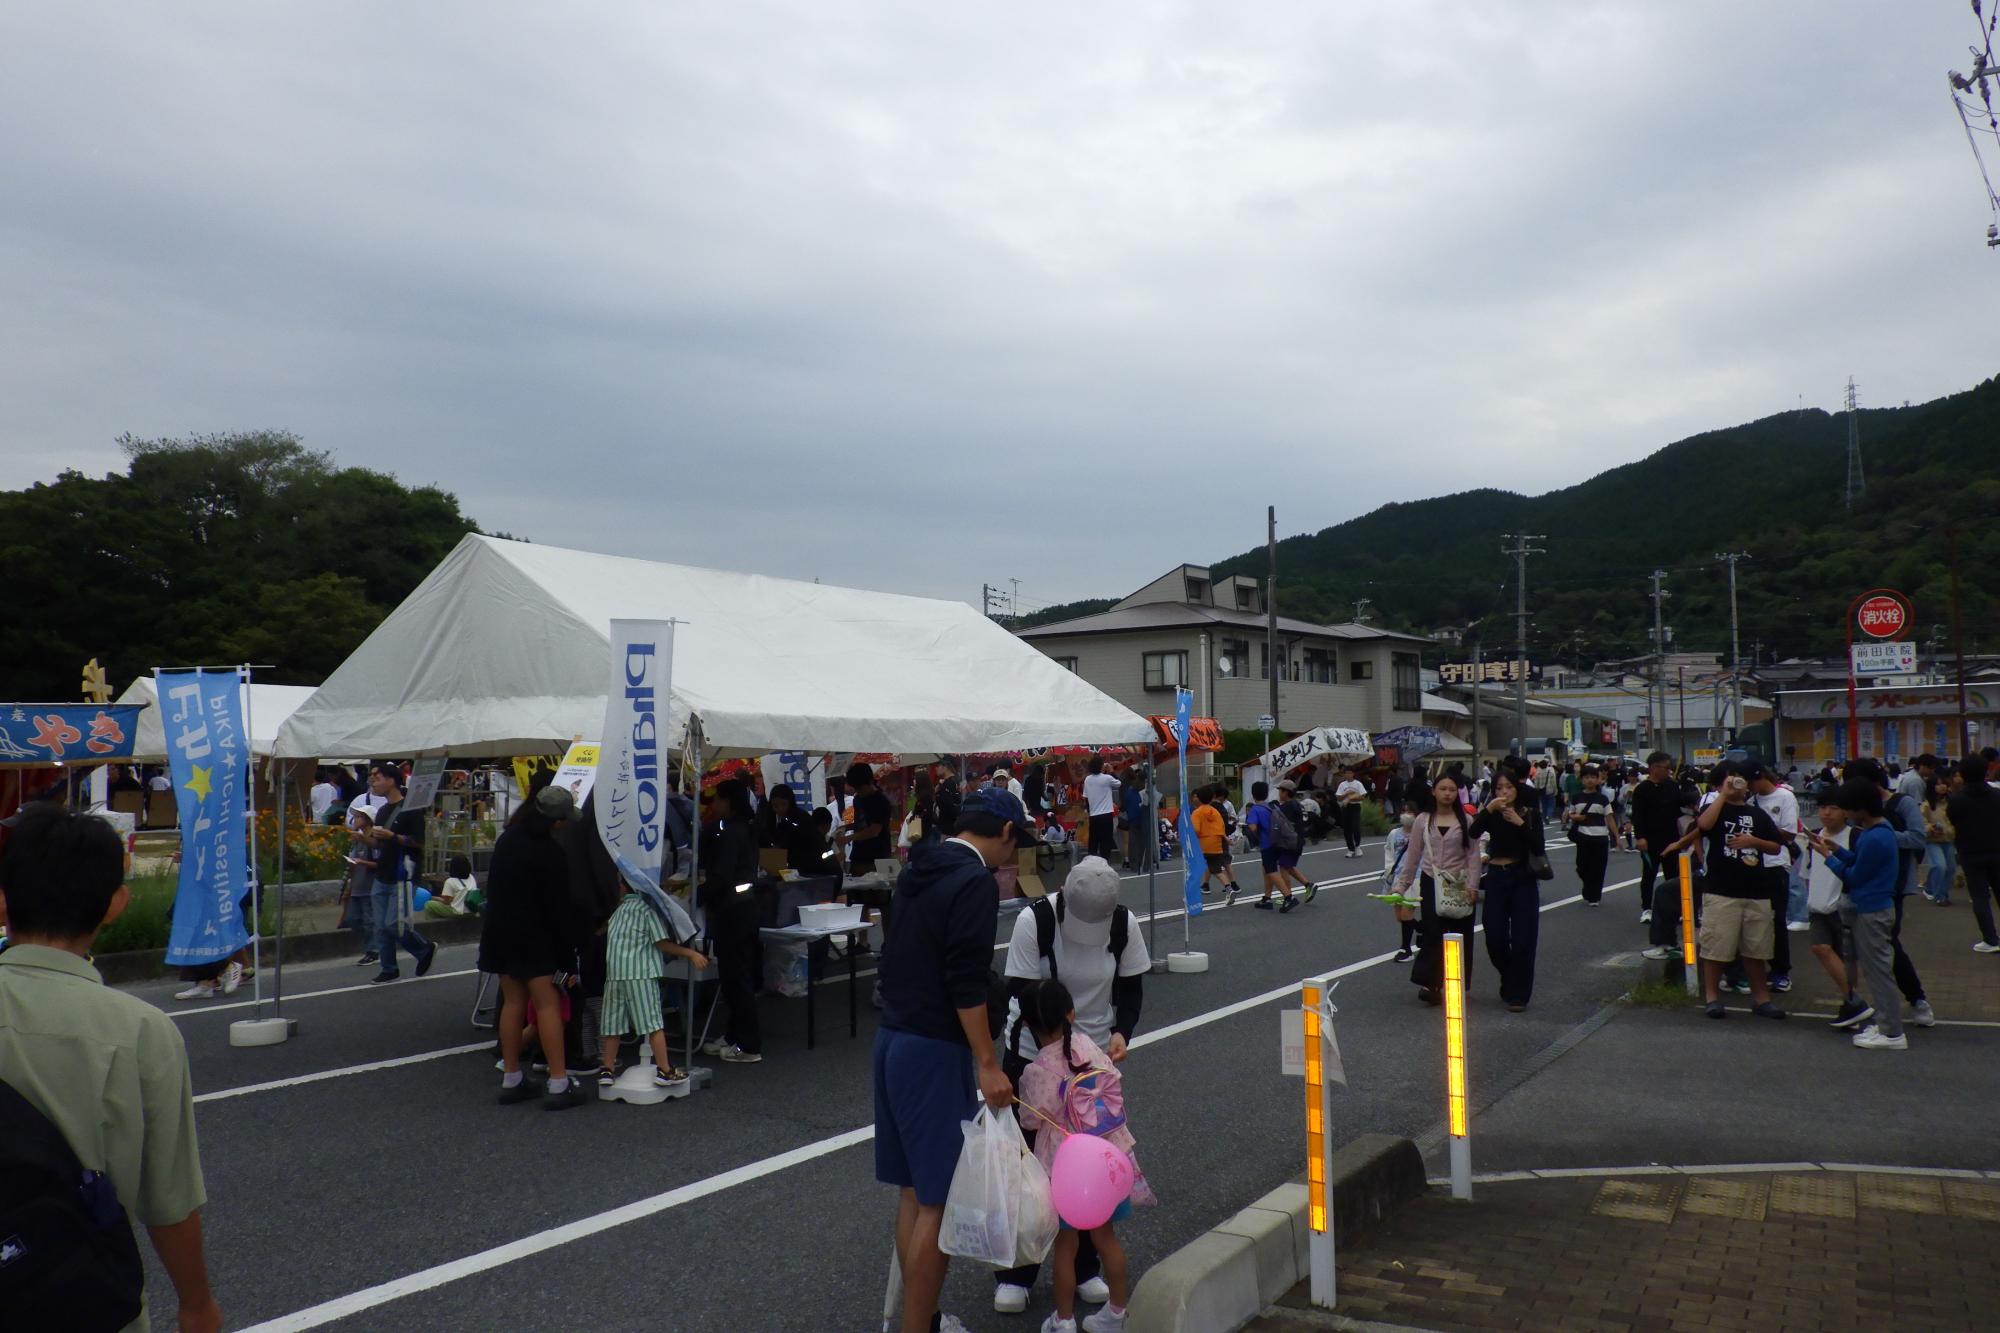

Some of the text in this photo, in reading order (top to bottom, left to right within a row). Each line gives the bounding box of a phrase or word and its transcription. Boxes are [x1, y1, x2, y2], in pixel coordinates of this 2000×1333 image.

[1863, 608, 1900, 625] 消火栓
[1858, 645, 1912, 657] 前田医院
[1440, 660, 1532, 683] 守田家具
[27, 711, 125, 757] やき
